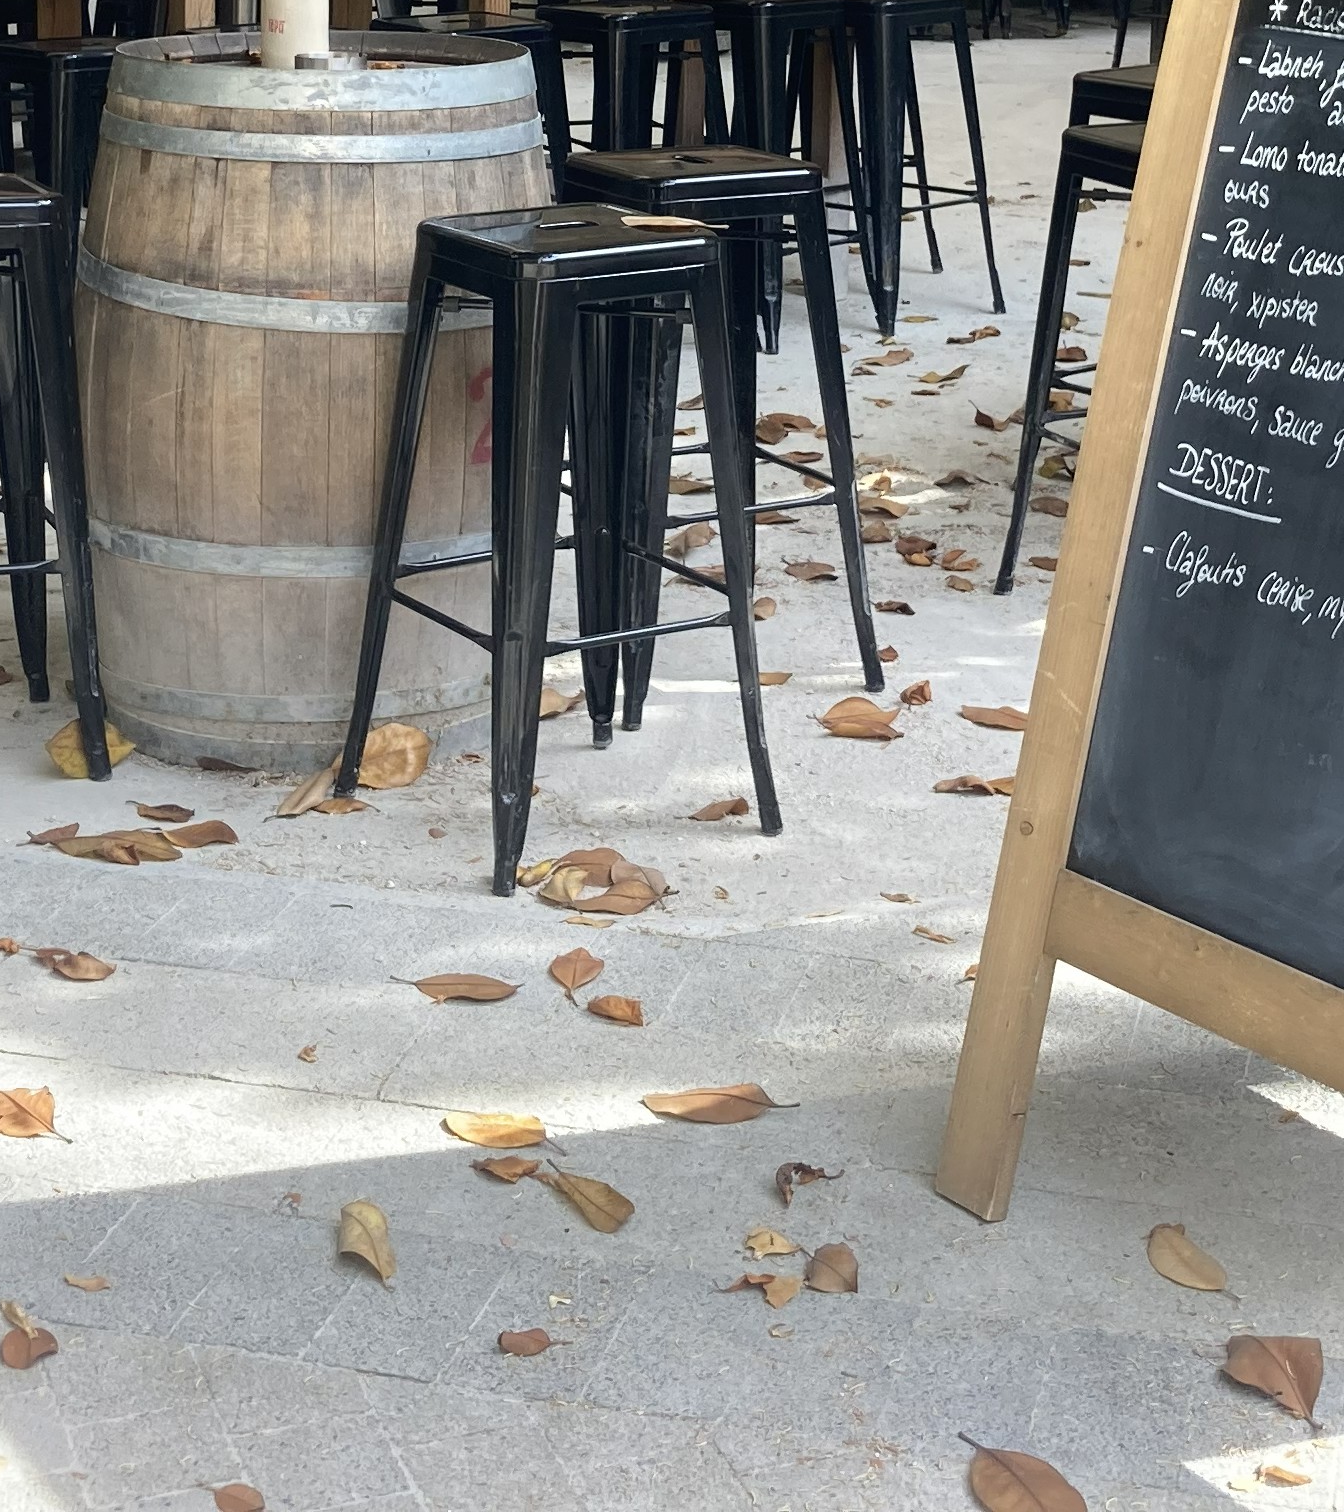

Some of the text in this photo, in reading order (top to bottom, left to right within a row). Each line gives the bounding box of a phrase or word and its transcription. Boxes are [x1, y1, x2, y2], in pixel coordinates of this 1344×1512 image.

[1258, 39, 1326, 91] Labneh,
[1240, 85, 1294, 124] pesto
[1240, 131, 1288, 171] Lomo
[1225, 179, 1269, 208] ours
[1223, 218, 1284, 264] Poulet
[1199, 322, 1285, 383] Asperges
[1174, 379, 1259, 434] poivrons,
[1268, 406, 1323, 445] sauce
[1166, 531, 1246, 597] Clafoutis
